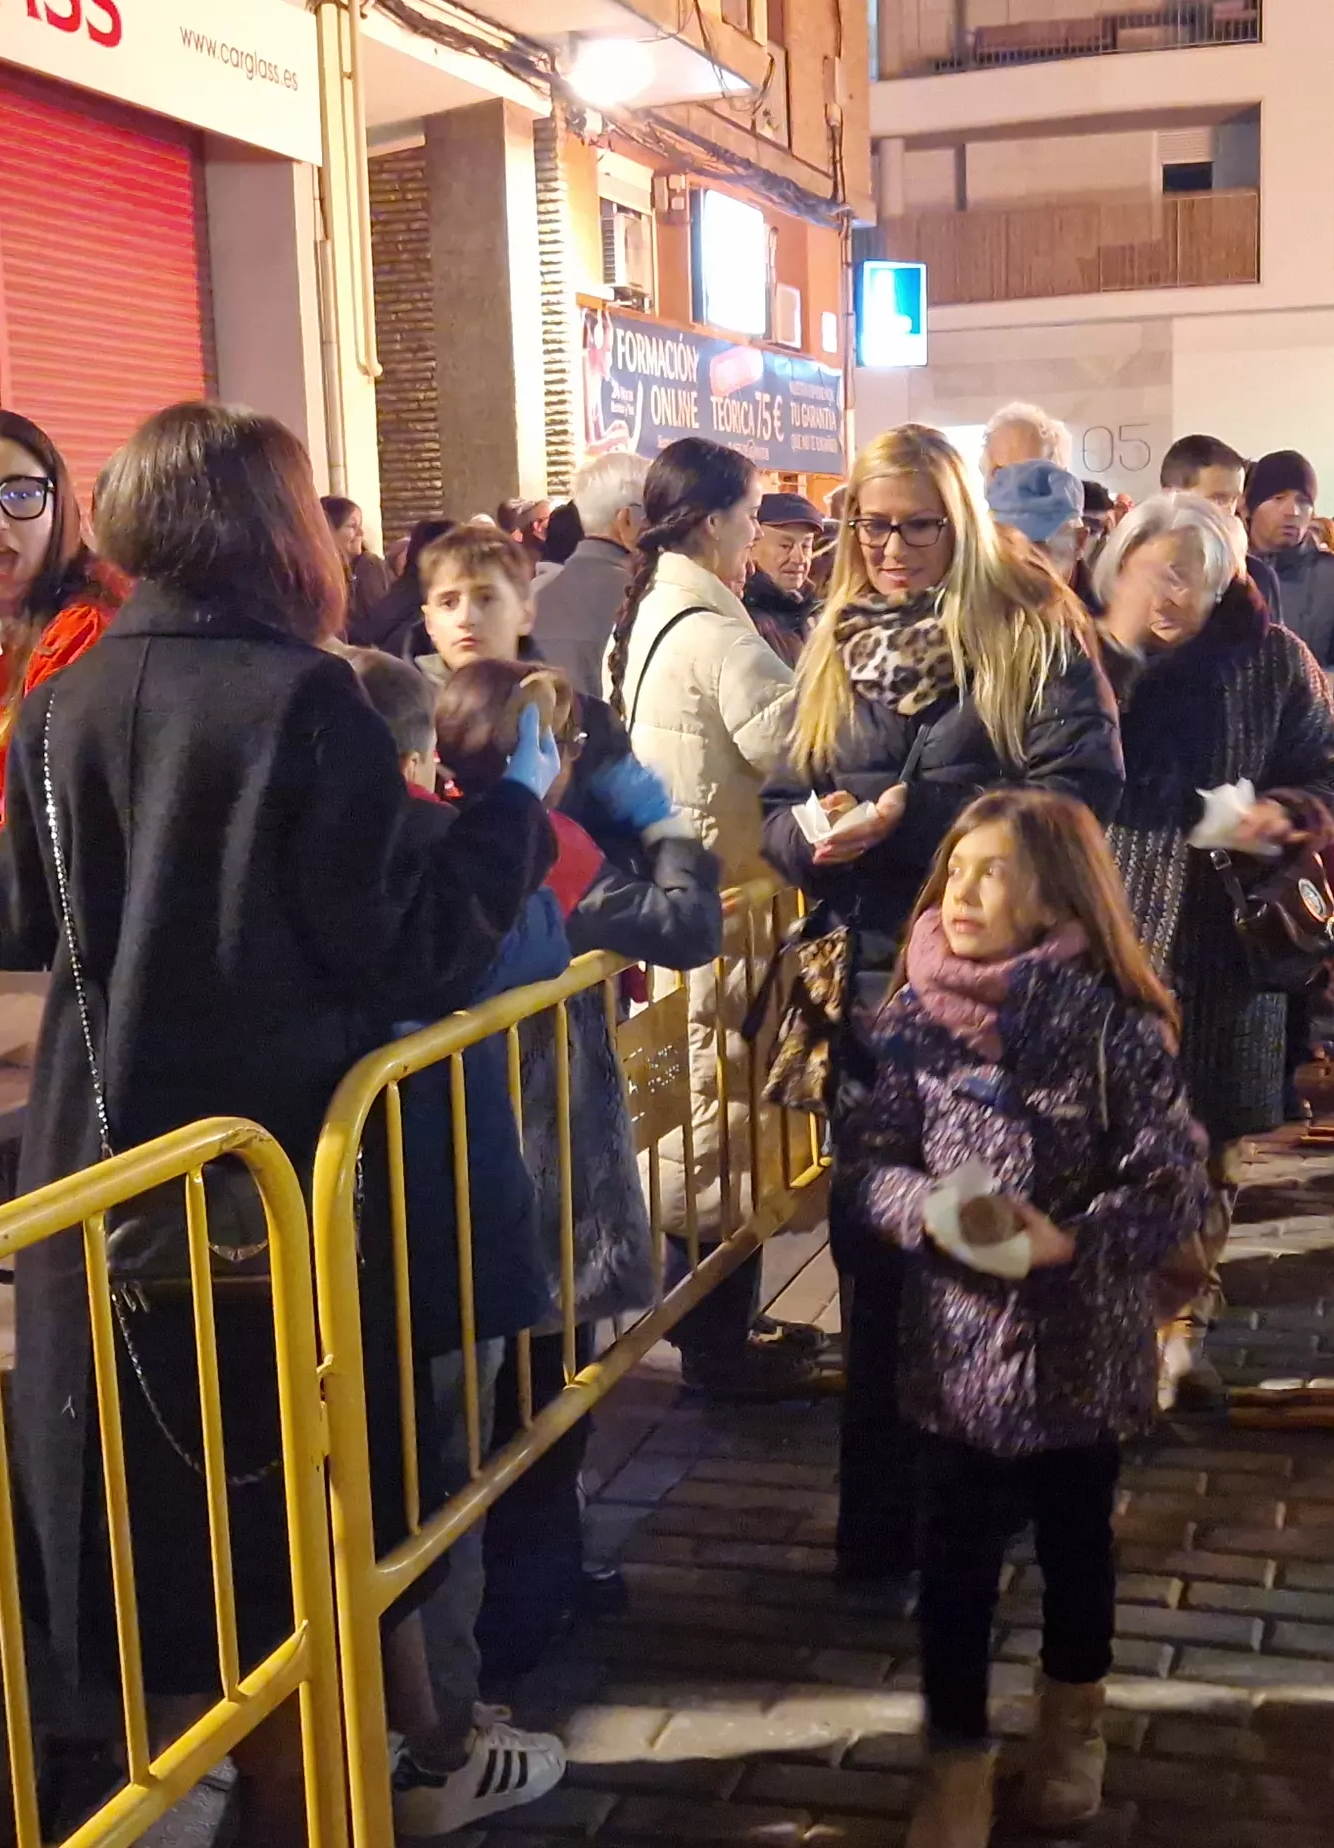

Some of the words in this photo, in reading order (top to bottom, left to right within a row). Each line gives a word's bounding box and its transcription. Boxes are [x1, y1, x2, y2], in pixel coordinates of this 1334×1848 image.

[179, 25, 299, 92] www.carglass.es
[616, 328, 699, 383] FORMACIÓN
[650, 384, 699, 429] ONLINE
[755, 391, 772, 441] 75
[773, 395, 785, 442] €
[1082, 423, 1151, 473] 05
